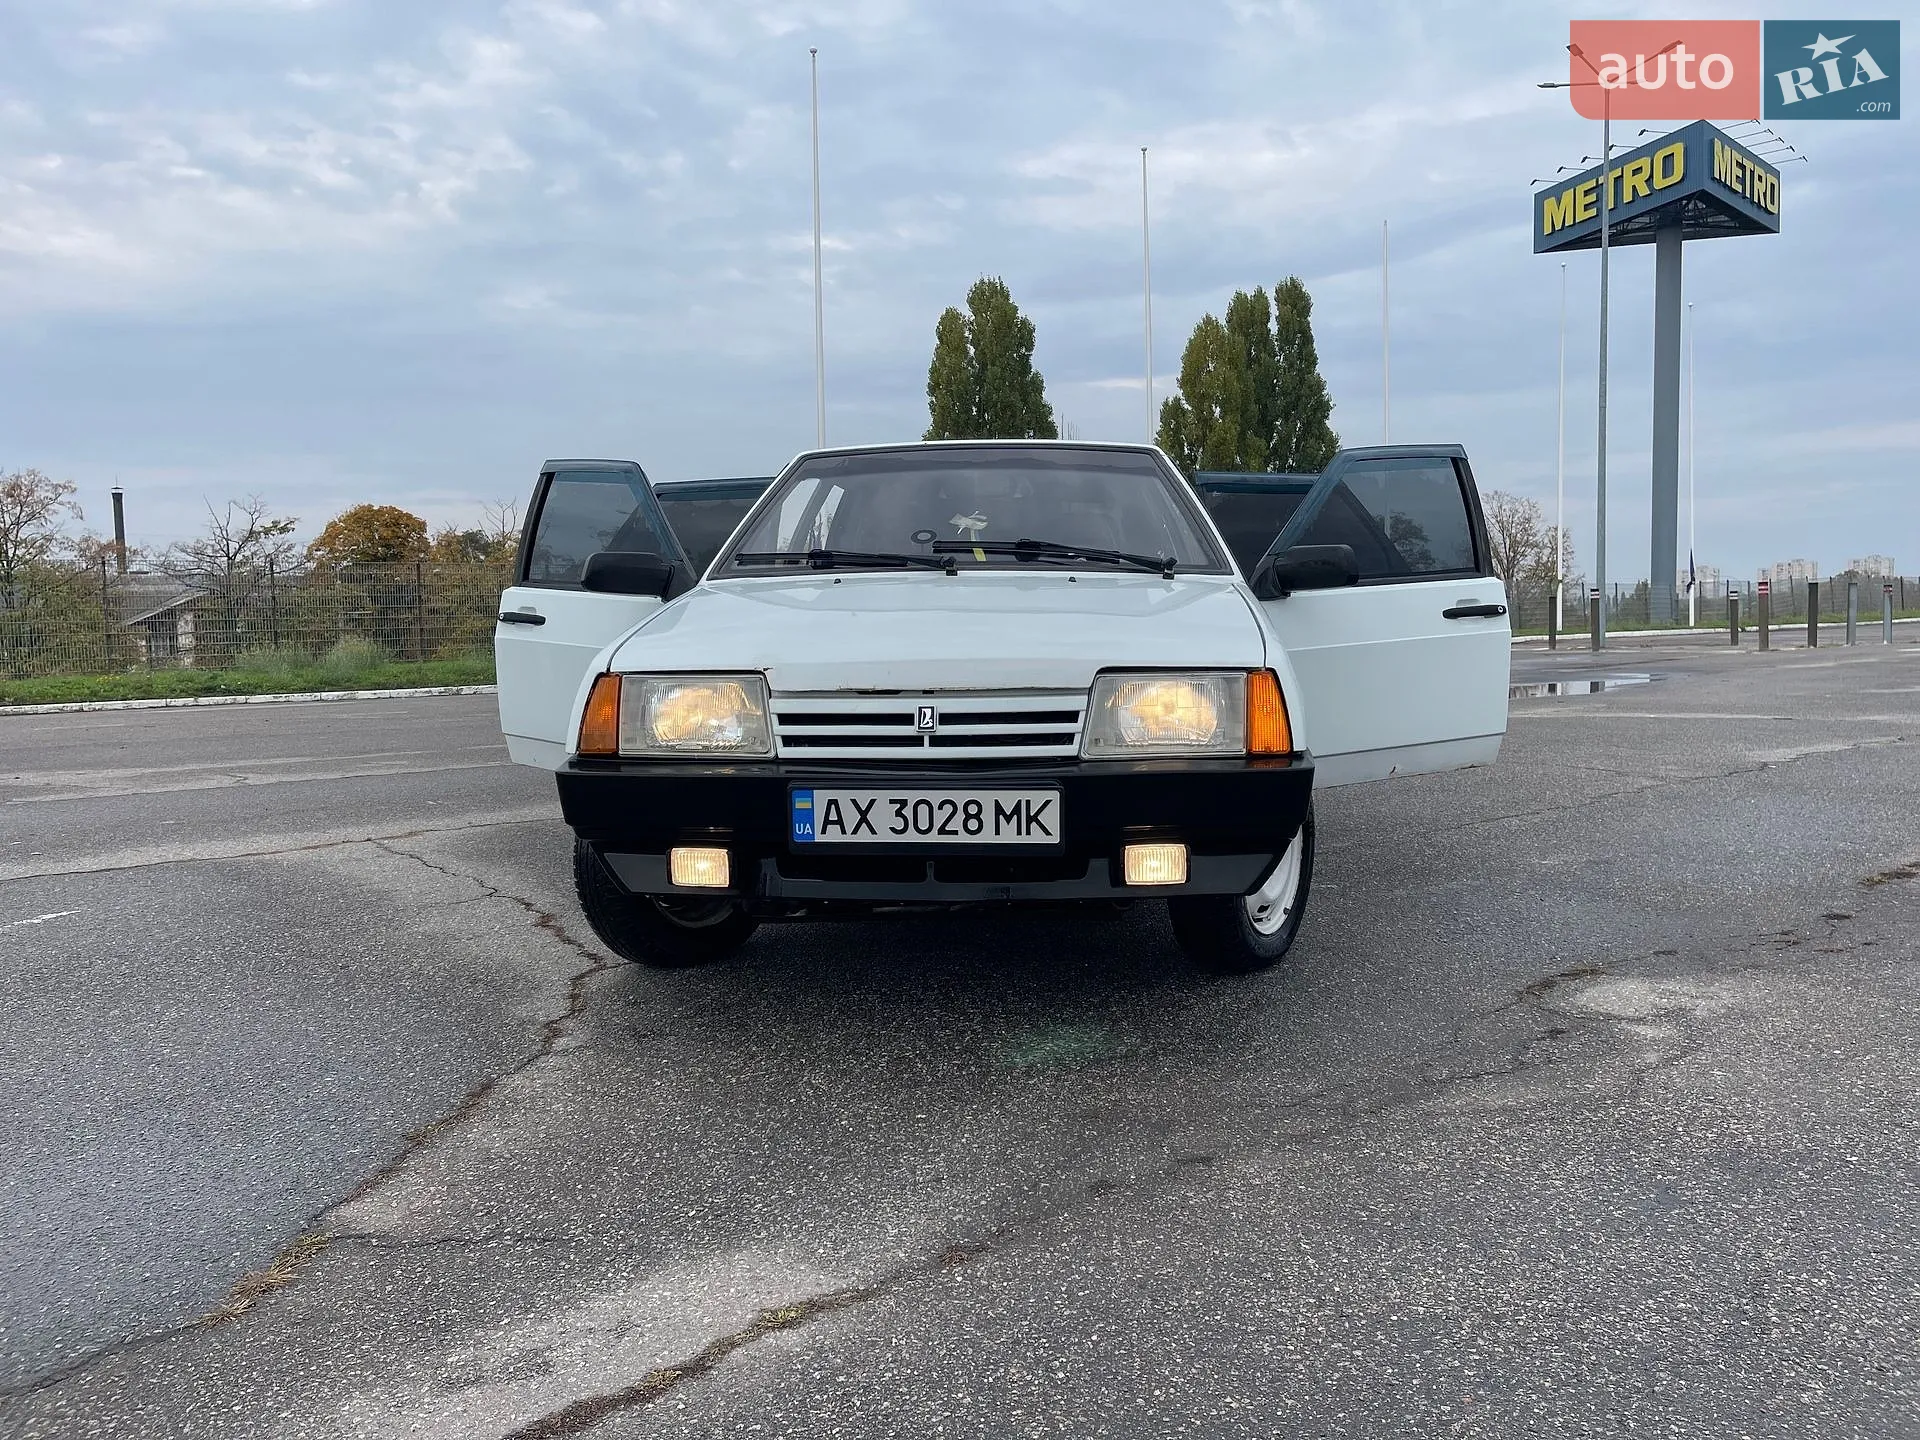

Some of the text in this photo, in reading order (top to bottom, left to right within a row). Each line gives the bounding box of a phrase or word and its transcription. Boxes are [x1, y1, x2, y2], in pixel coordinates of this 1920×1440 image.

[1543, 142, 1685, 236] METRO
[1714, 137, 1780, 215] METRO
[795, 823, 813, 835] UA
[820, 798, 1054, 837] AX 3028 MK
